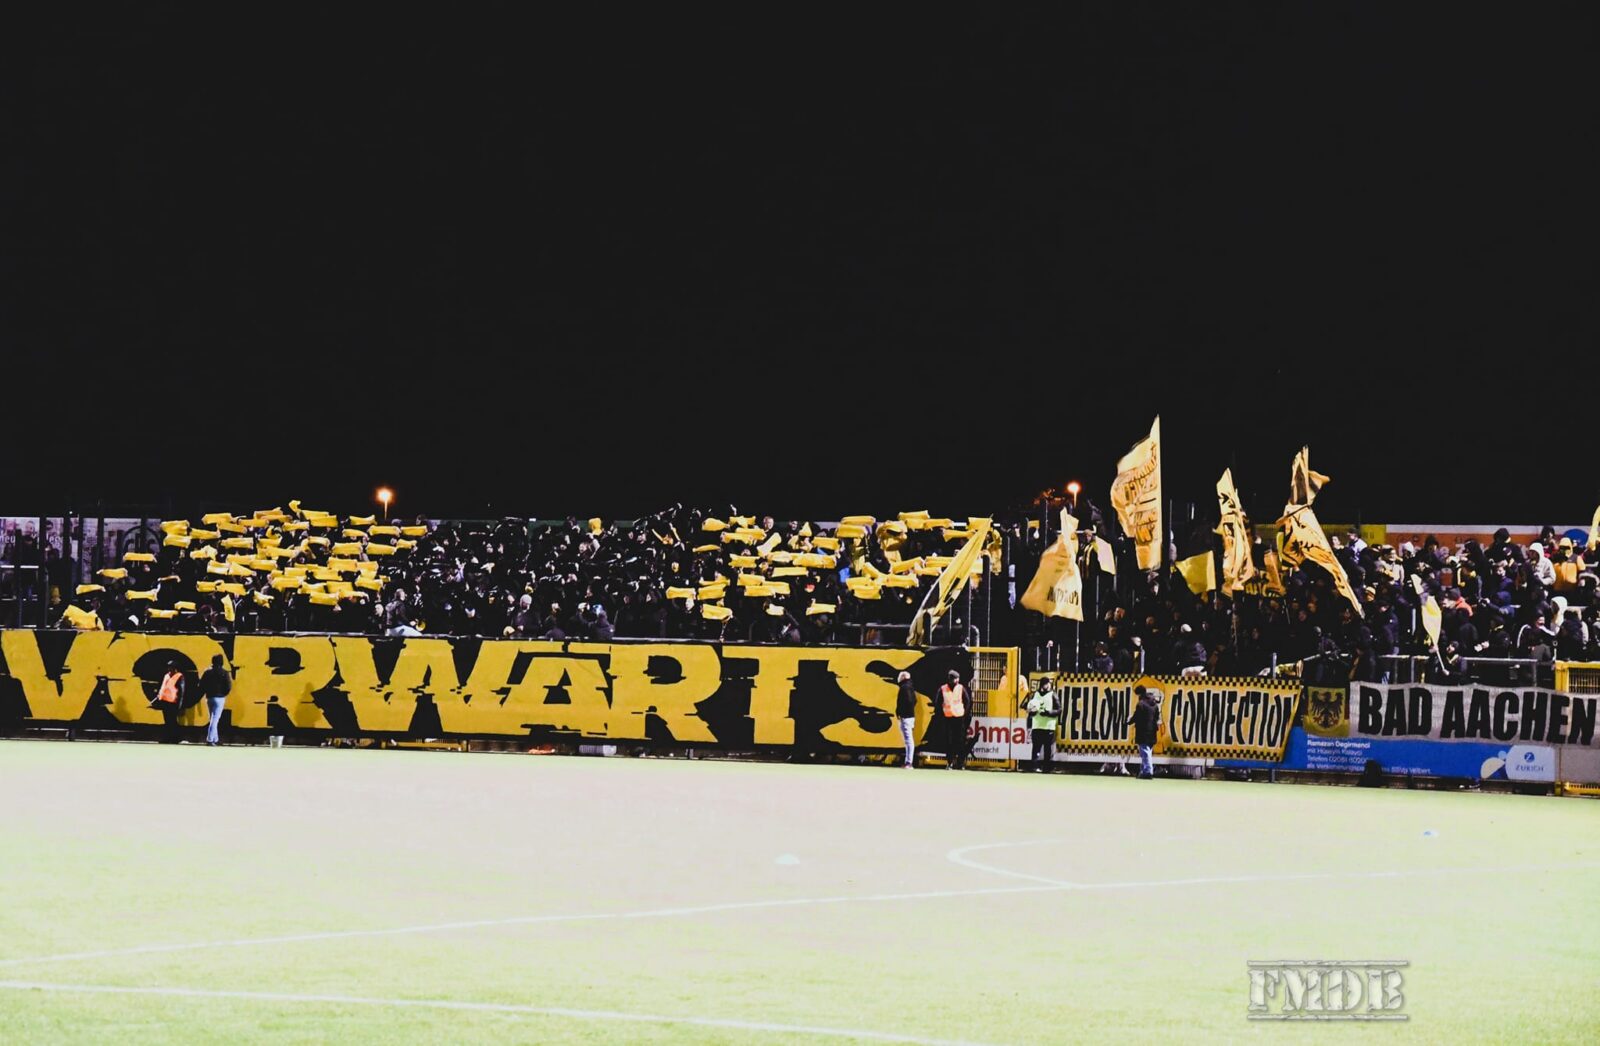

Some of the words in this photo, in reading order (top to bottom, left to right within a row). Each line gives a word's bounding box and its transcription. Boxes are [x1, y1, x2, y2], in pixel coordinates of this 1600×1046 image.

[1058, 685, 1131, 741] YELLOW
[1169, 688, 1298, 748] CONNECTION
[1358, 685, 1433, 736] BAD
[1440, 688, 1597, 745] AACHEN
[1515, 764, 1544, 773] ZURICH
